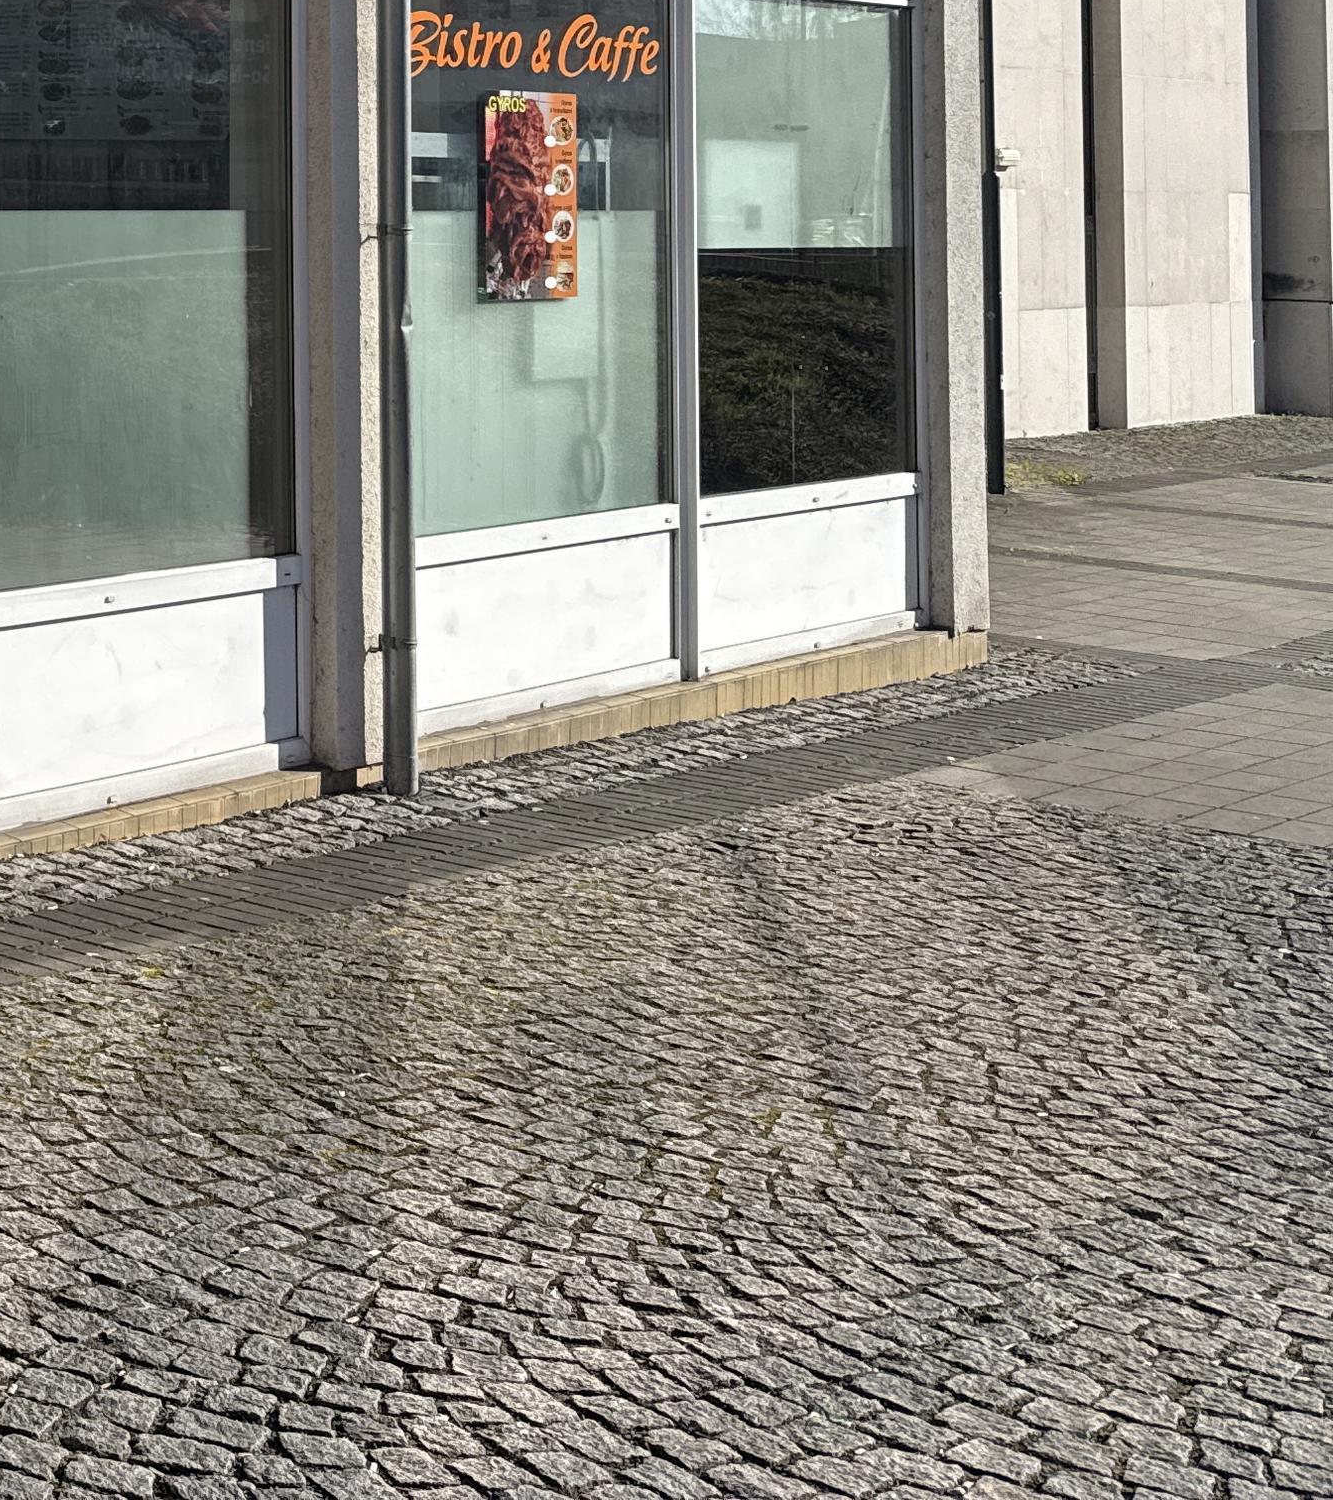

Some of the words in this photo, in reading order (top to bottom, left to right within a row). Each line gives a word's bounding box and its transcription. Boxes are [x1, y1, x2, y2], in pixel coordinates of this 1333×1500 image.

[411, 10, 523, 78] Bistro
[531, 28, 551, 74] &
[557, 13, 660, 83] Caffe
[488, 95, 527, 113] GYROS
